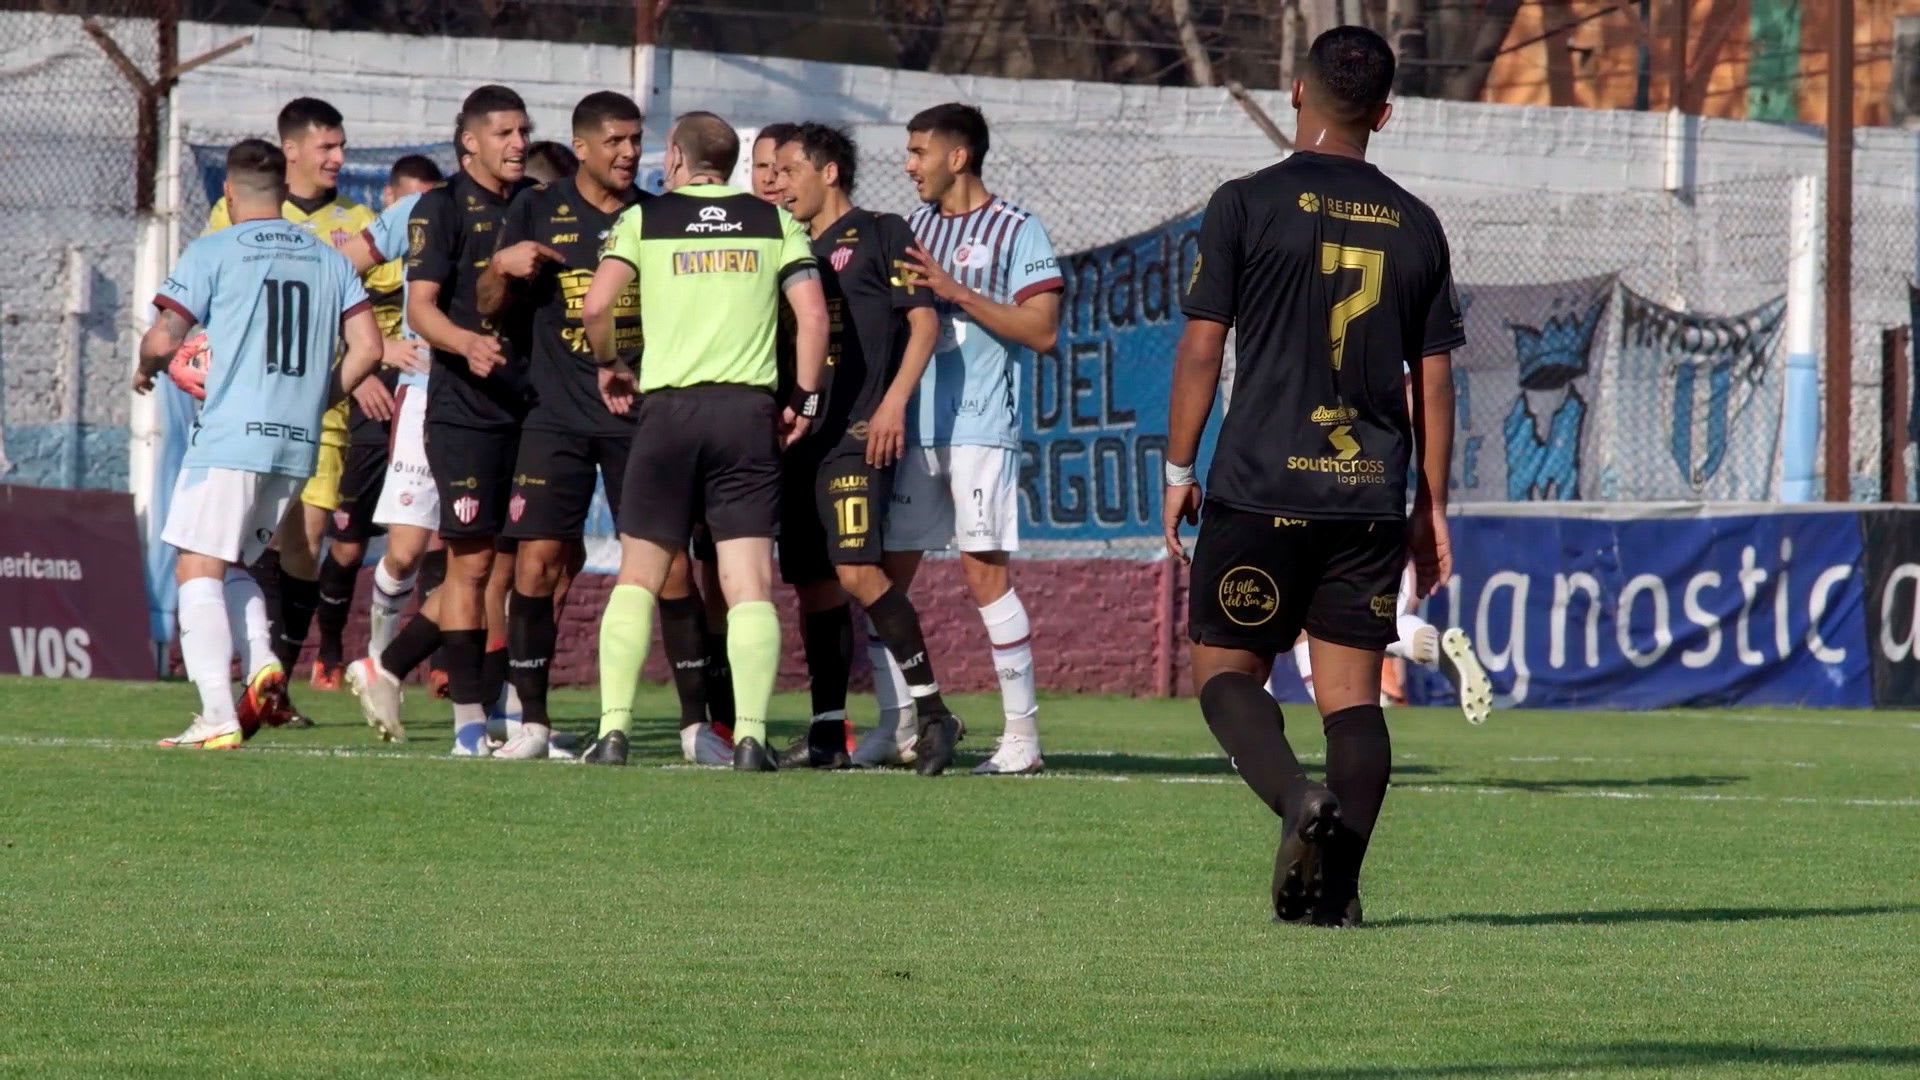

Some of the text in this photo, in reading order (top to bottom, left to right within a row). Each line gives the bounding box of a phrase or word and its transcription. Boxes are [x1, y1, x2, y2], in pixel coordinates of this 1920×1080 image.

[685, 221, 742, 232] ATHIX
[1327, 198, 1400, 221] REFRIVAN
[1320, 243, 1384, 370] 7
[263, 279, 309, 377] 10
[1032, 340, 1136, 433] DEL
[1287, 456, 1385, 473] southcross
[1337, 474, 1386, 486] logistics
[833, 496, 869, 535] 10
[0, 551, 82, 580] ericana
[9, 626, 92, 679] VOS
